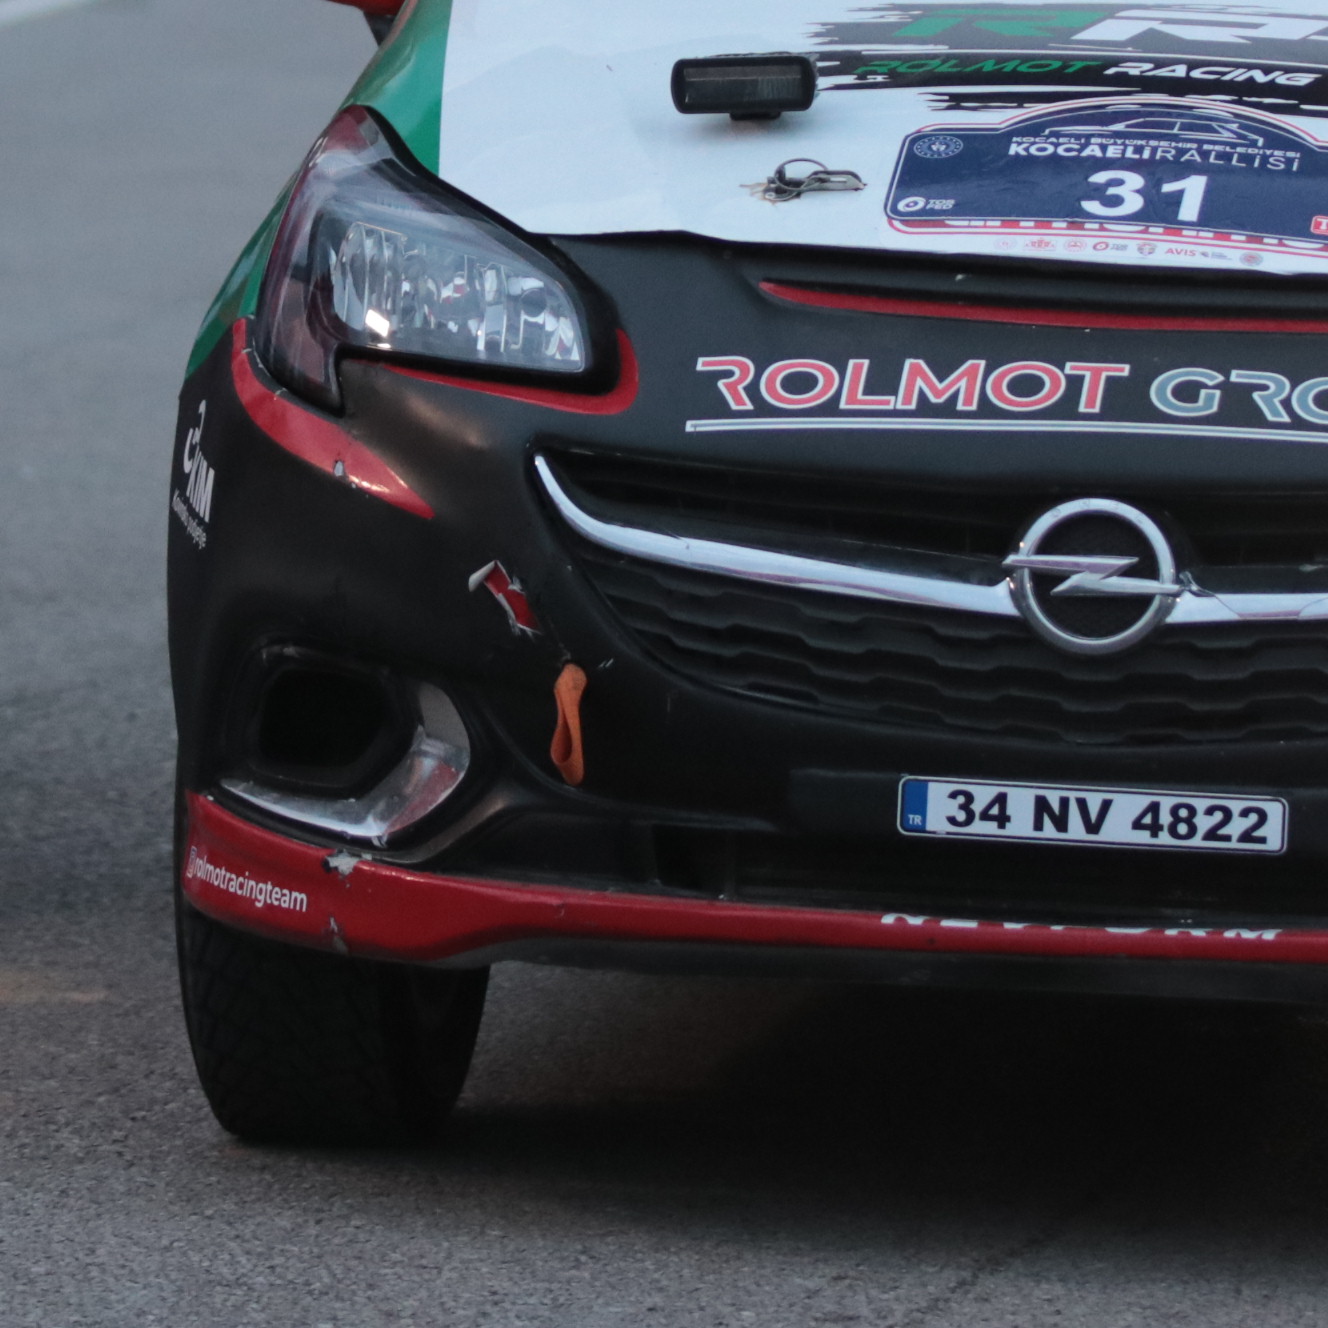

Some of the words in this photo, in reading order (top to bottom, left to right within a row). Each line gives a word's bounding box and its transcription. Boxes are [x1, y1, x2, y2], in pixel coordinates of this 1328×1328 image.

[855, 57, 1104, 74] ROLMOT
[1103, 61, 1322, 86] RACING
[1080, 169, 1208, 222] 31
[1164, 247, 1197, 257] AVIS
[696, 356, 1130, 413] ROLMOT
[907, 813, 923, 826] TR
[944, 789, 1012, 830] 34
[1032, 794, 1114, 836] NV
[1130, 800, 1269, 845] 4822
[194, 854, 308, 913] rolmotracingteam
